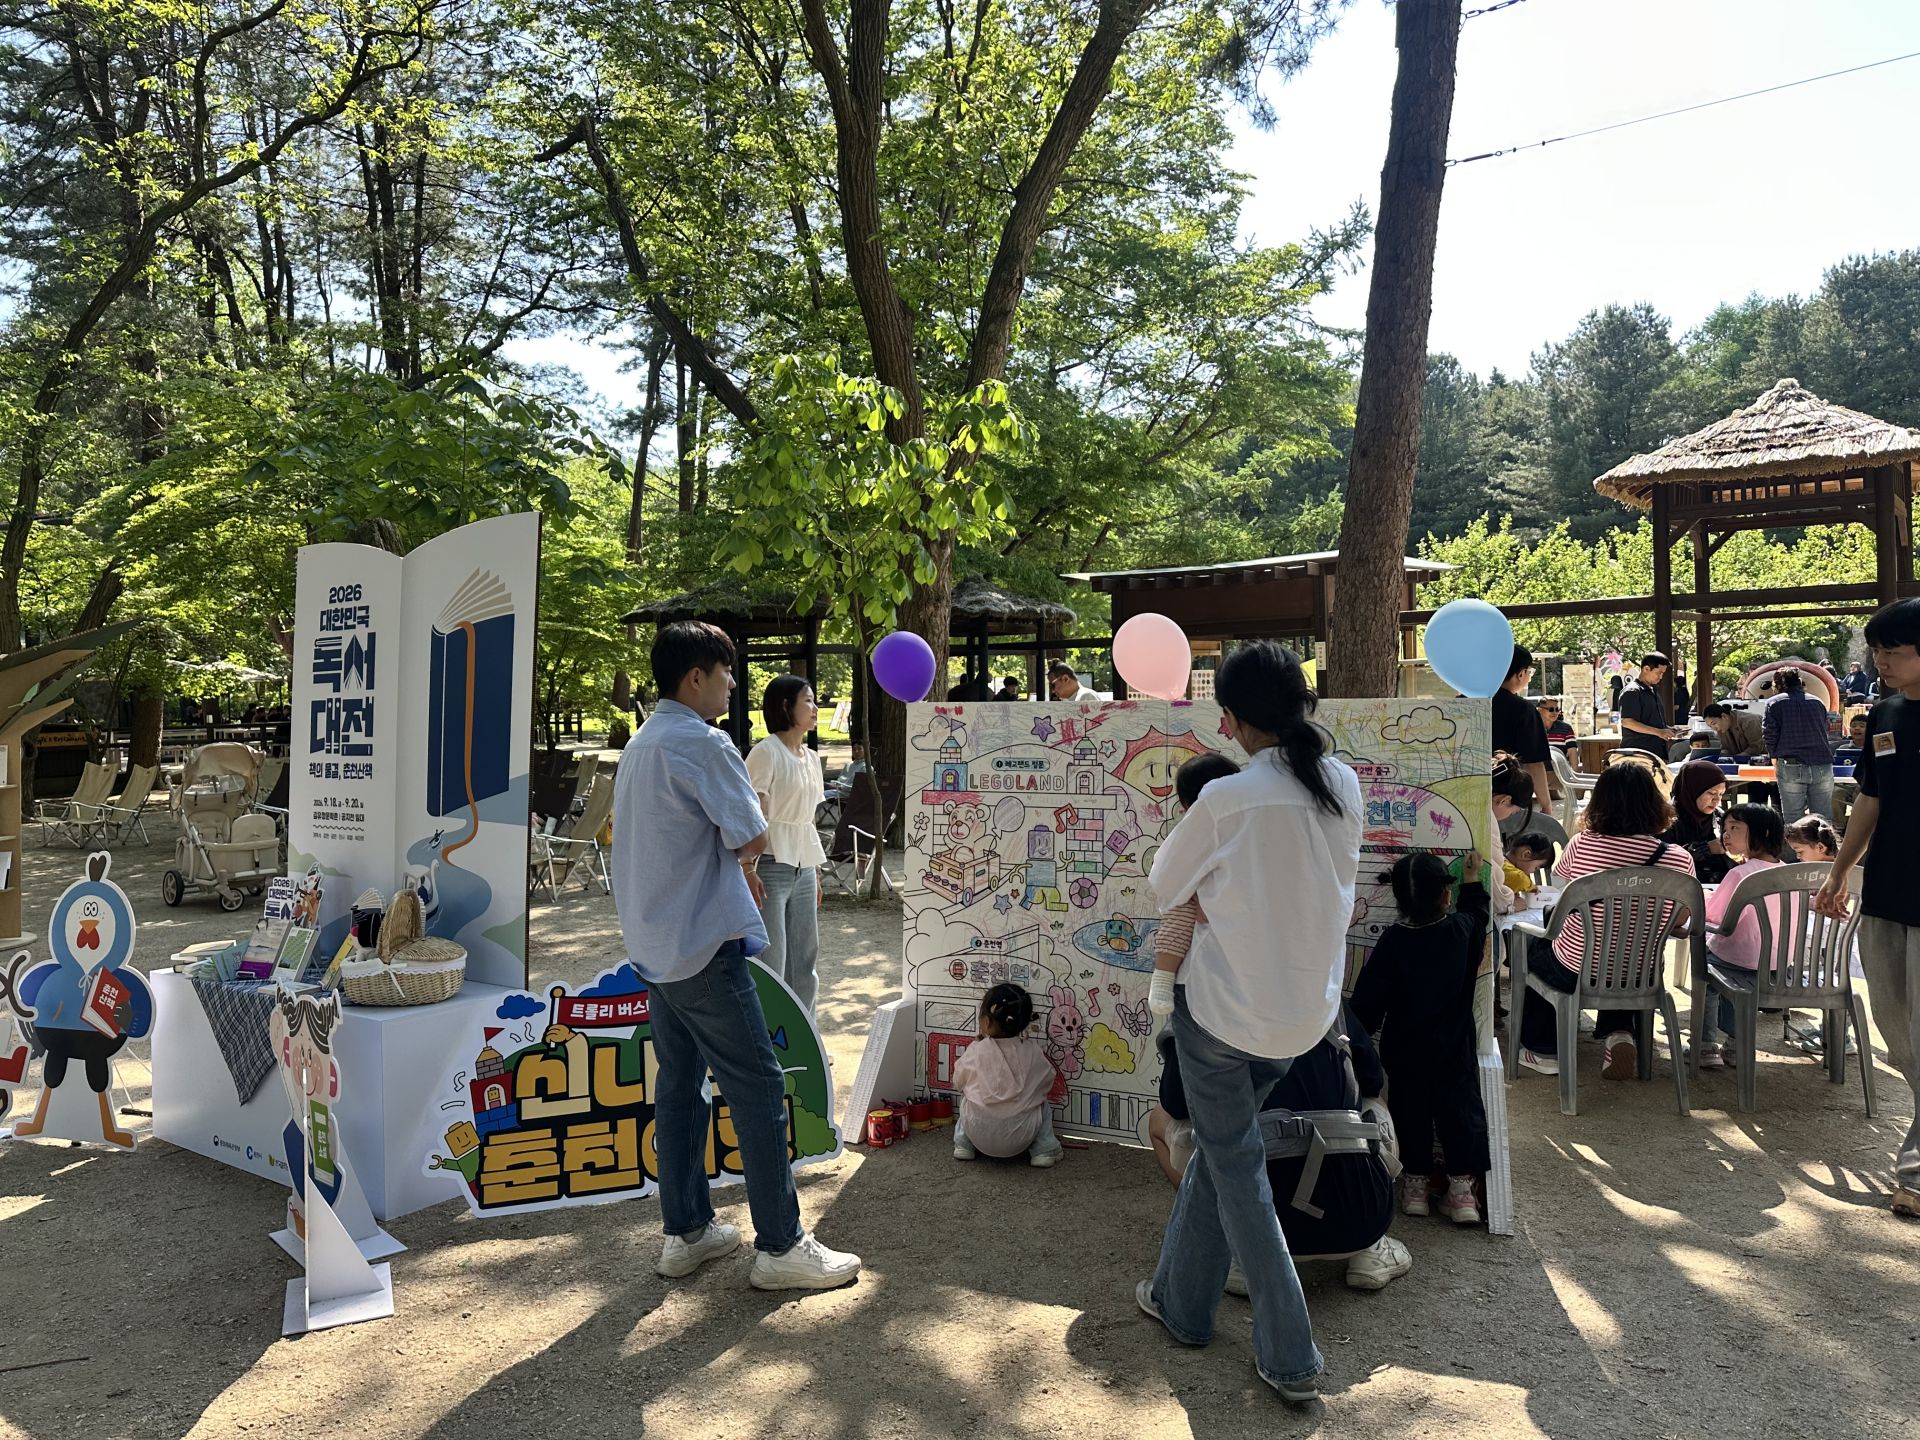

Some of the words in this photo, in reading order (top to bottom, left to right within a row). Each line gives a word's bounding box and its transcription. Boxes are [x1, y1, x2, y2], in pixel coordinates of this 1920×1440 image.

[329, 584, 362, 604] 2026
[320, 605, 370, 632] 대한민국
[313, 632, 376, 693] 독서
[310, 696, 374, 756] 대전
[343, 762, 373, 780] 춘천산책
[1004, 760, 1030, 769] 레고랜드
[1360, 766, 1373, 776] 2번
[1375, 766, 1391, 776] 출구
[969, 773, 1065, 791] LEGOLAND
[1363, 800, 1417, 827] 천역
[274, 878, 290, 887] 2026
[983, 940, 1003, 950] 춘천역
[970, 960, 1030, 987] 춘천역
[570, 1003, 614, 1020] 트롤리
[617, 999, 650, 1017] 버스
